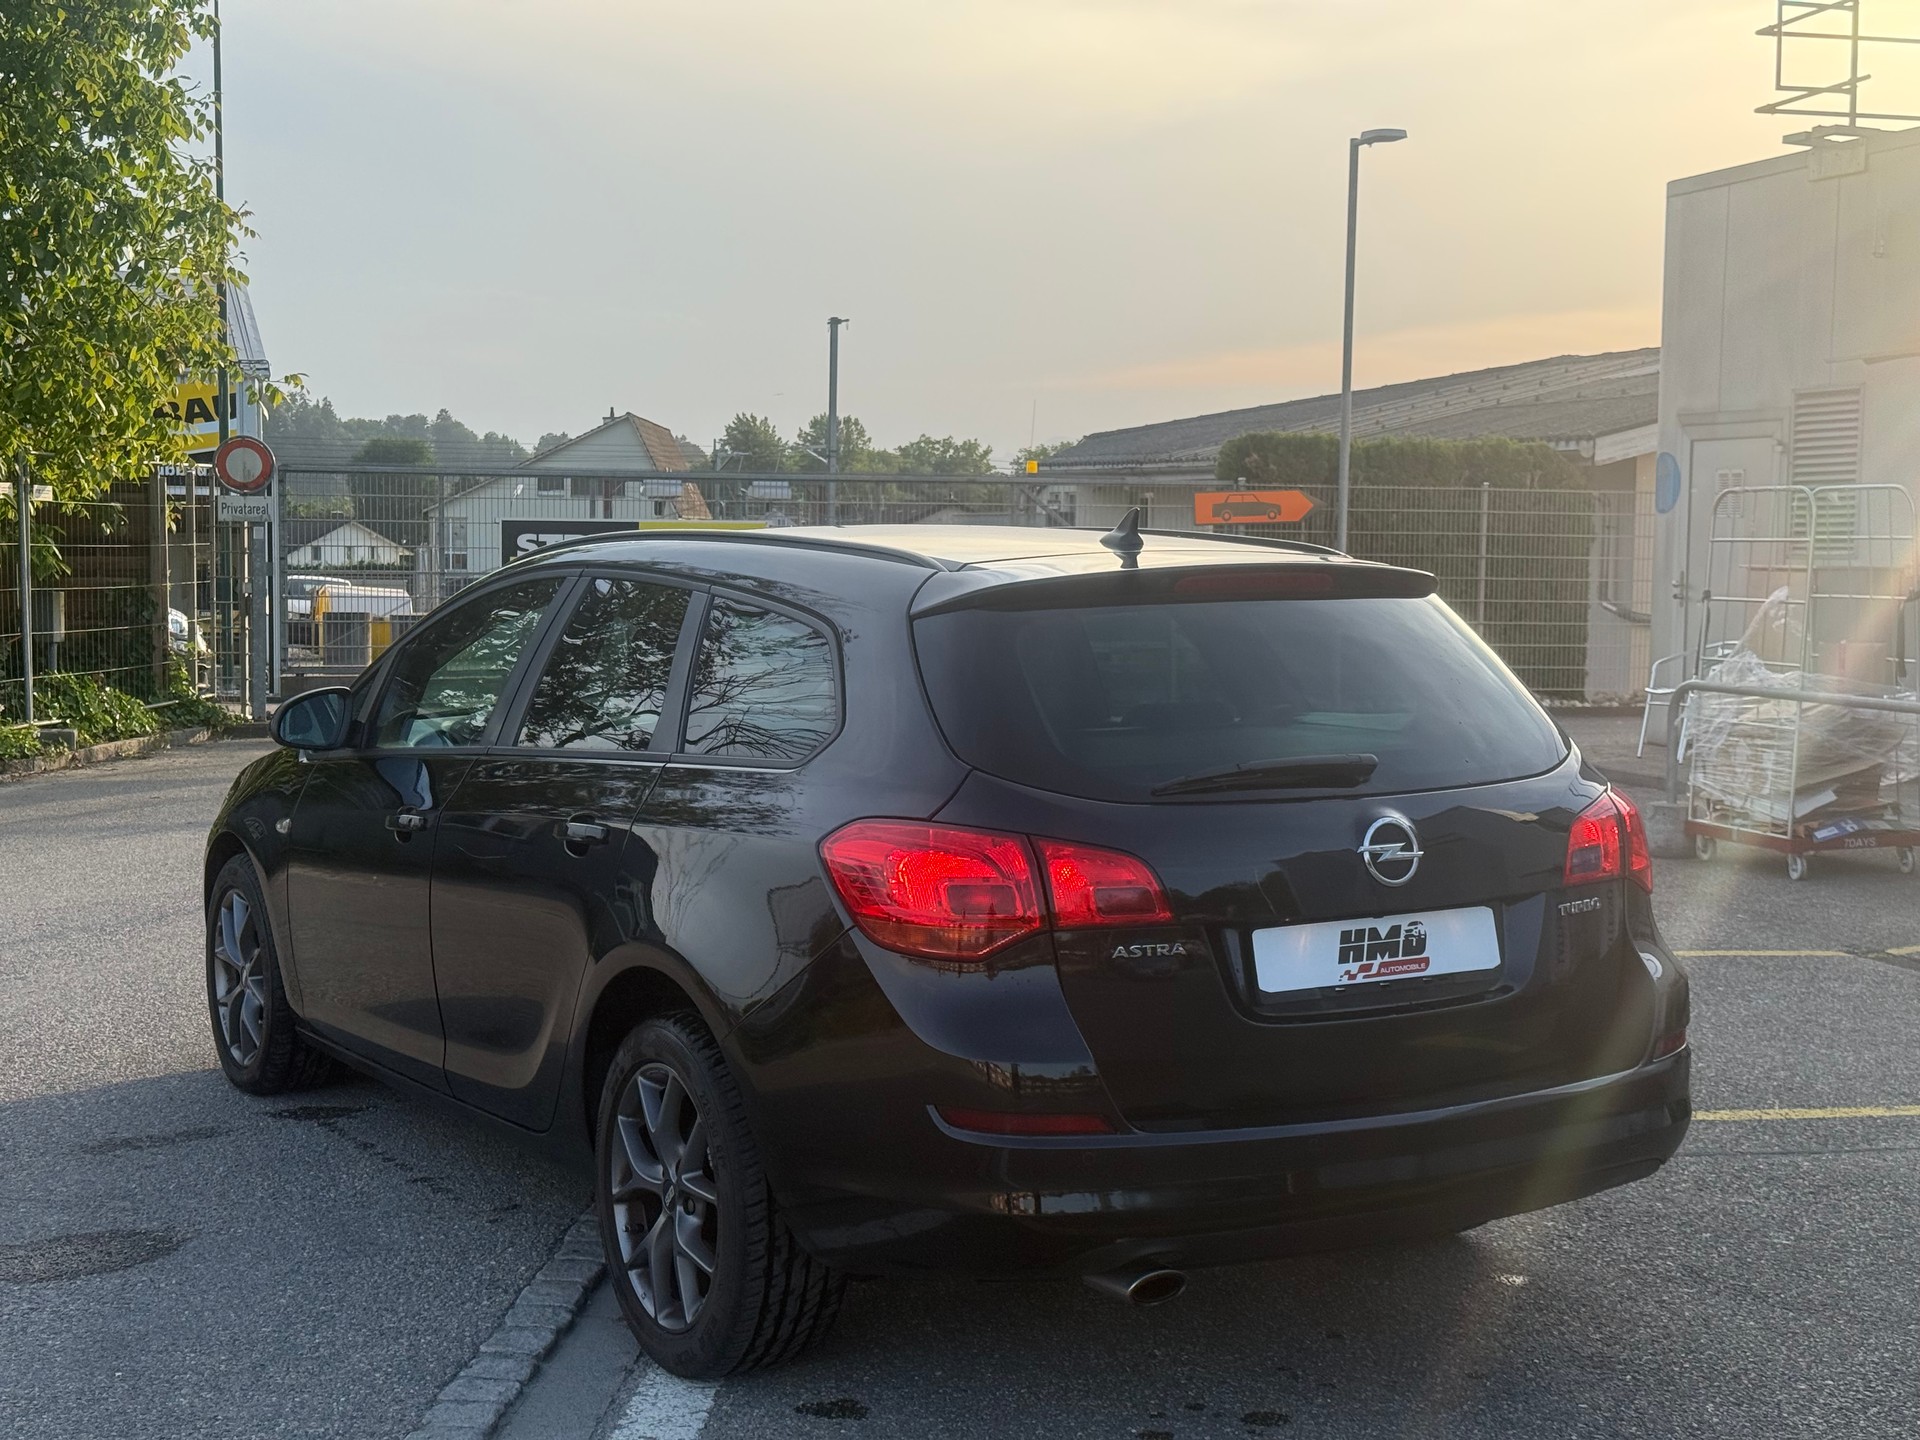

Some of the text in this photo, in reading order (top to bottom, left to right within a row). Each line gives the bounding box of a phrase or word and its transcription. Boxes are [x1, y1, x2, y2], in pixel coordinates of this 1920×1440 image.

[221, 502, 269, 515] Privatareal
[516, 533, 587, 558] ST
[1844, 837, 1876, 848] 7DAYS
[1112, 942, 1187, 958] ASTRA
[1338, 921, 1427, 965] HMD
[1380, 962, 1426, 974] AUTOMOBILE
